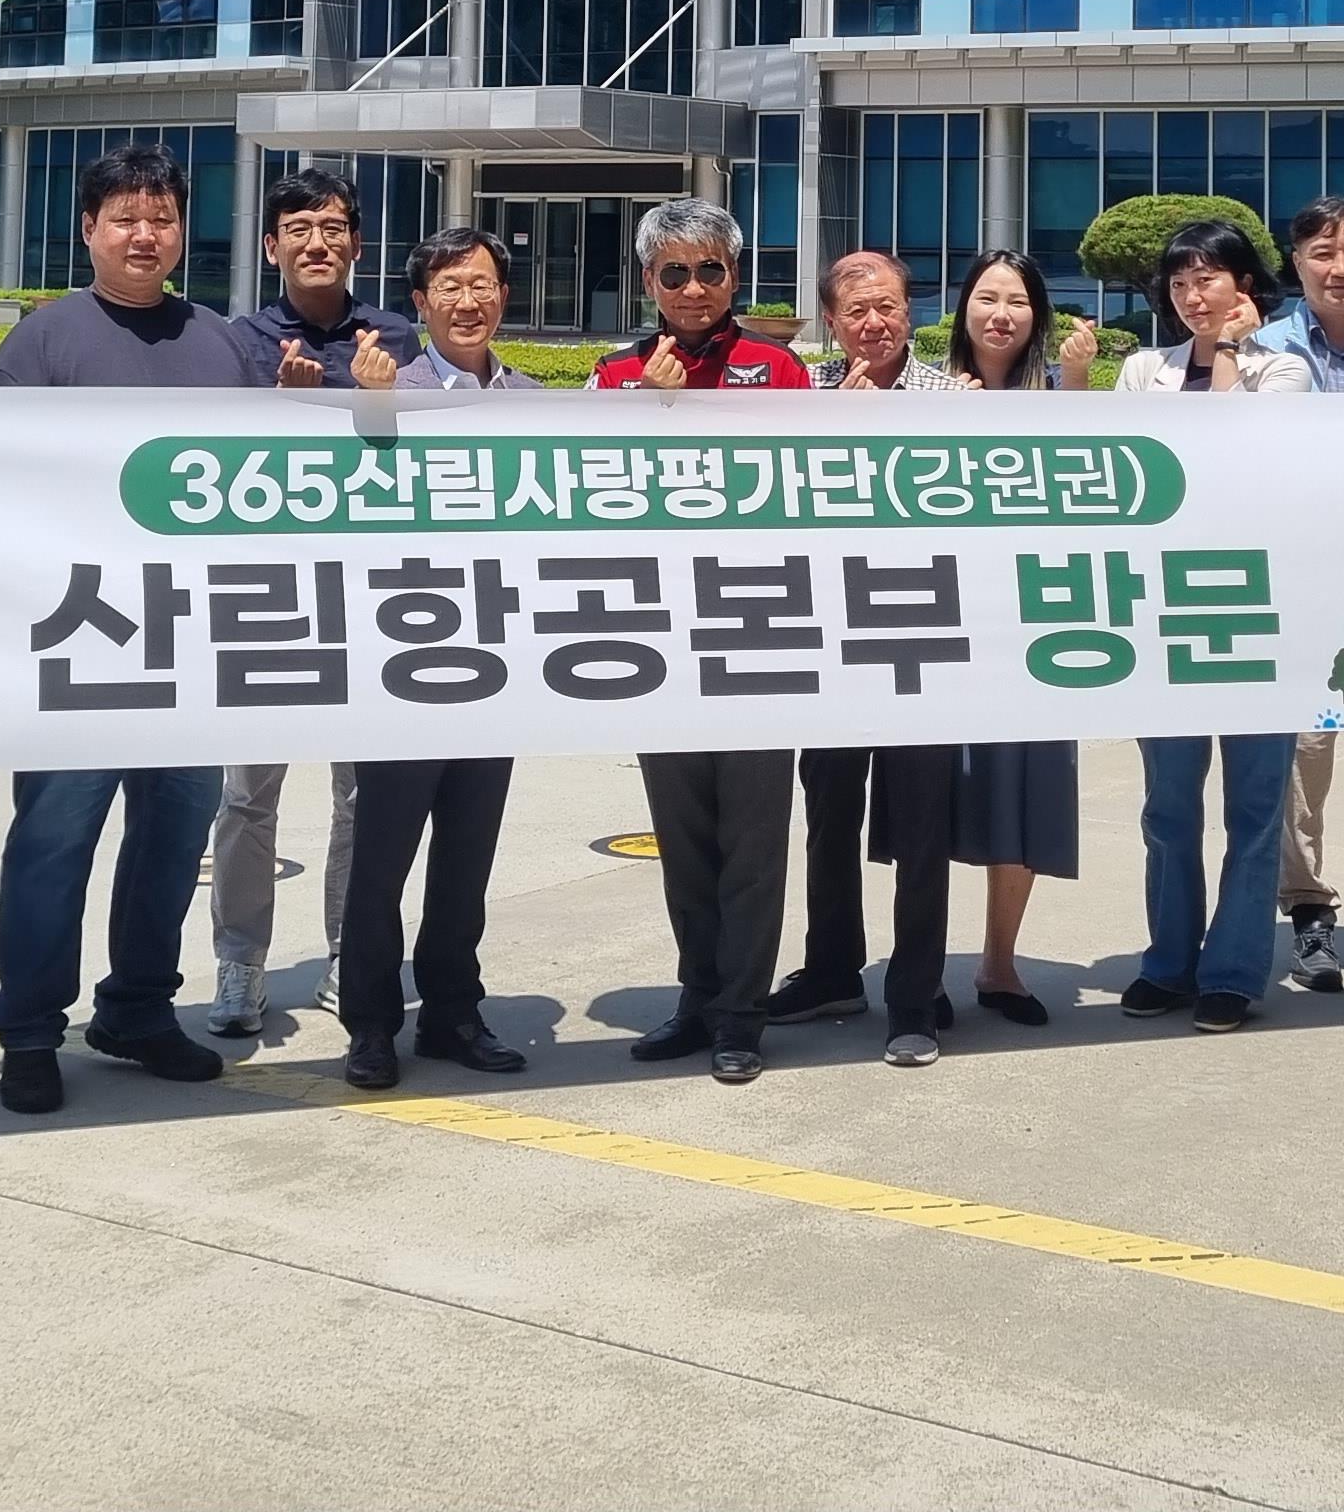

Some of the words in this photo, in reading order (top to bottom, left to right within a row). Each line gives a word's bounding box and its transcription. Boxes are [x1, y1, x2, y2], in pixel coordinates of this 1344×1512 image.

[167, 445, 1147, 524] 365산림사랑평가단(강원권)
[29, 553, 972, 713] 산림항공본부
[1016, 550, 1280, 689] 방문
